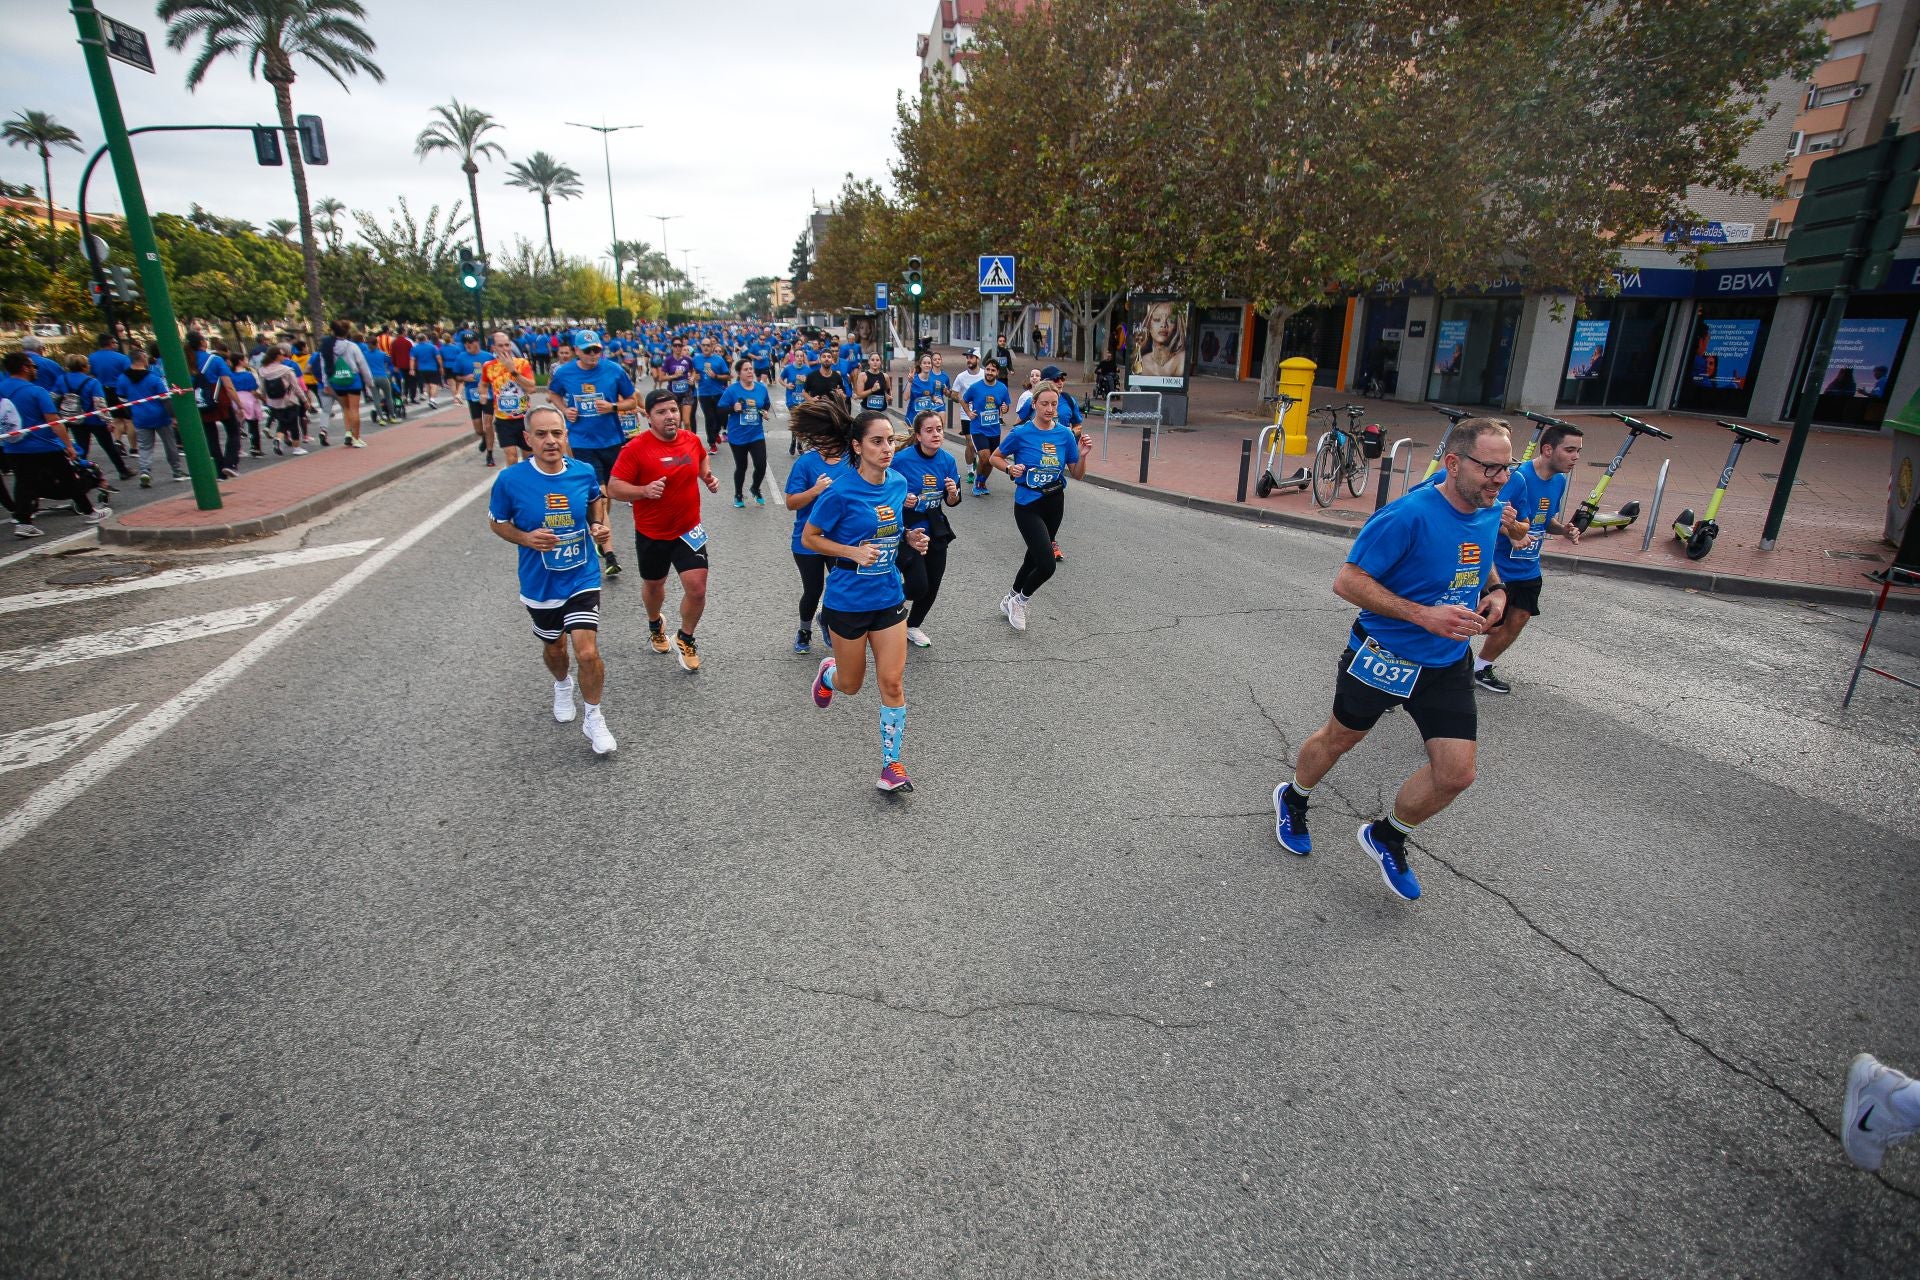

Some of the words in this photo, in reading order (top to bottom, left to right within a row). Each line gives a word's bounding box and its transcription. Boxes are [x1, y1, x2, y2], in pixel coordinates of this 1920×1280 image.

[1689, 224, 1722, 237] achadas
[1718, 271, 1774, 291] BBVA
[1033, 474, 1053, 483] 832
[552, 543, 580, 560] 746
[1363, 655, 1415, 683] 1037
